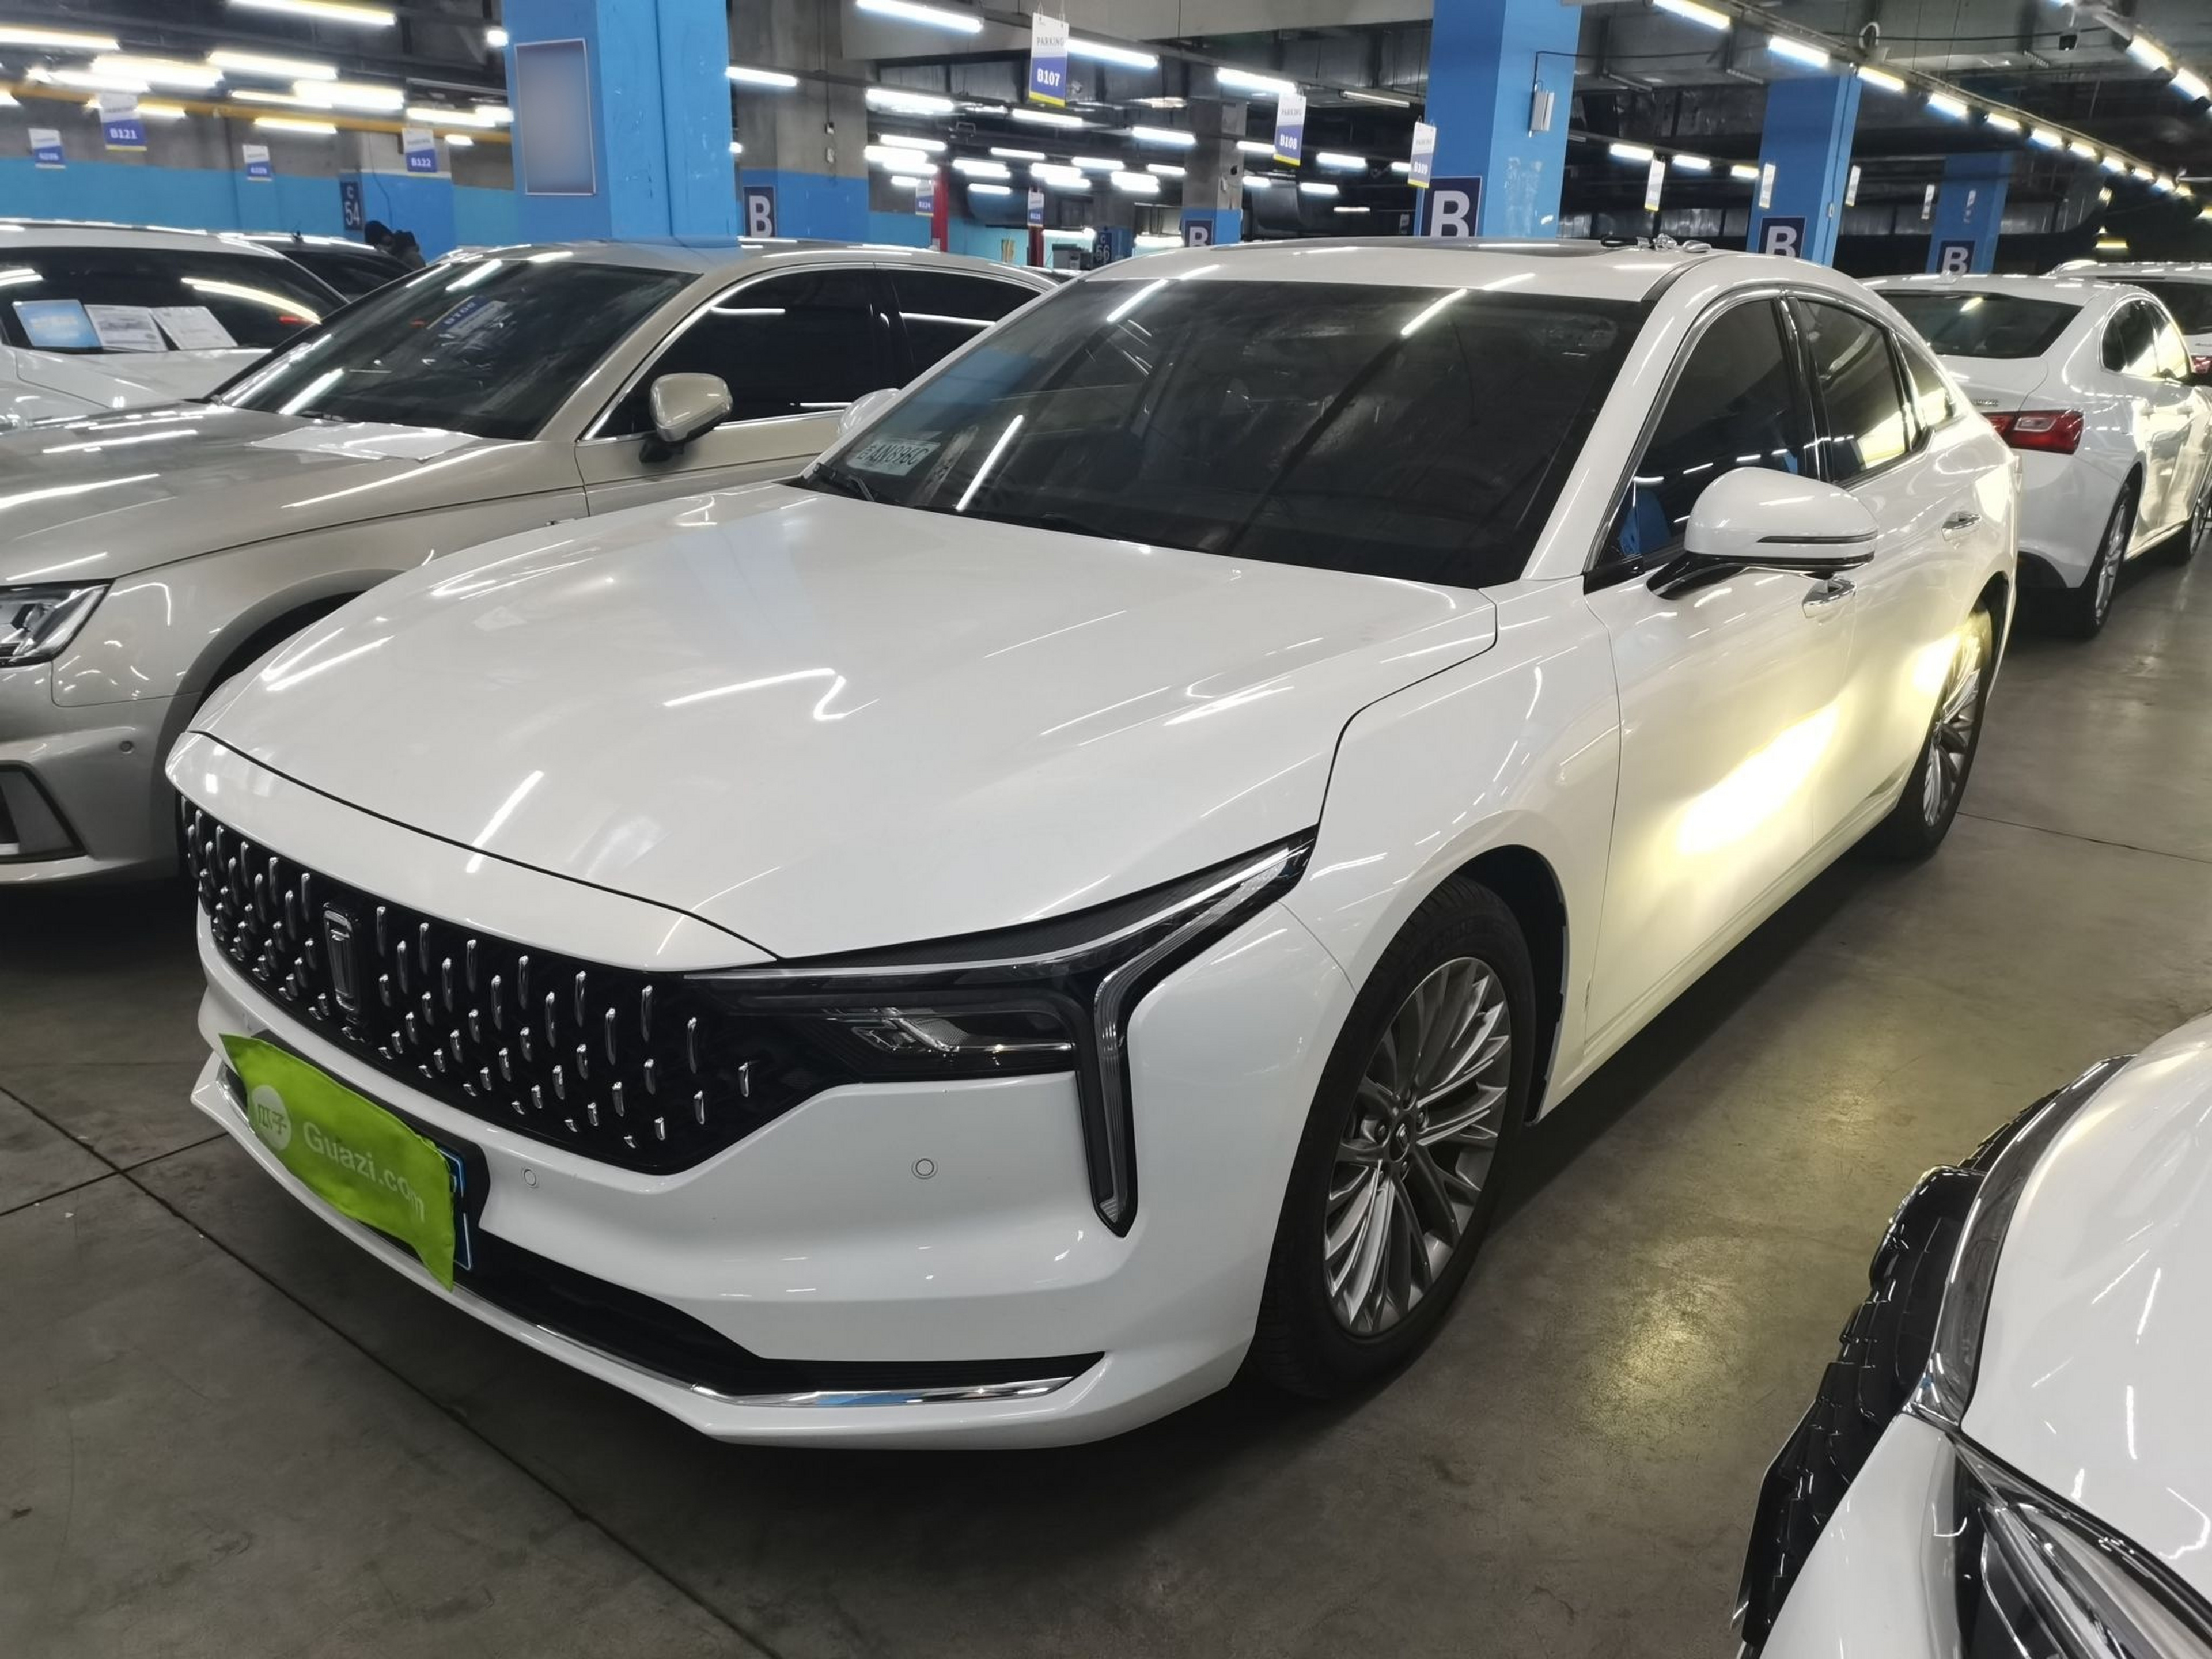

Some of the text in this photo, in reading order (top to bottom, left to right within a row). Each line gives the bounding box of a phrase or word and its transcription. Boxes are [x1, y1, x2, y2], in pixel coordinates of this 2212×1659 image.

[1037, 36, 1064, 46] PARKING
[1037, 68, 1060, 86] B107
[109, 128, 138, 139] B121
[1280, 134, 1297, 150] B108
[411, 157, 432, 168] B122
[1414, 161, 1428, 175] B109
[347, 186, 354, 199] C
[345, 202, 360, 225] 54
[749, 195, 772, 238] B
[1430, 191, 1470, 237] B
[1766, 226, 1797, 257] B
[1942, 247, 1968, 275] B
[257, 1104, 288, 1134] 瓜子
[302, 1122, 425, 1223] Guazi.com
